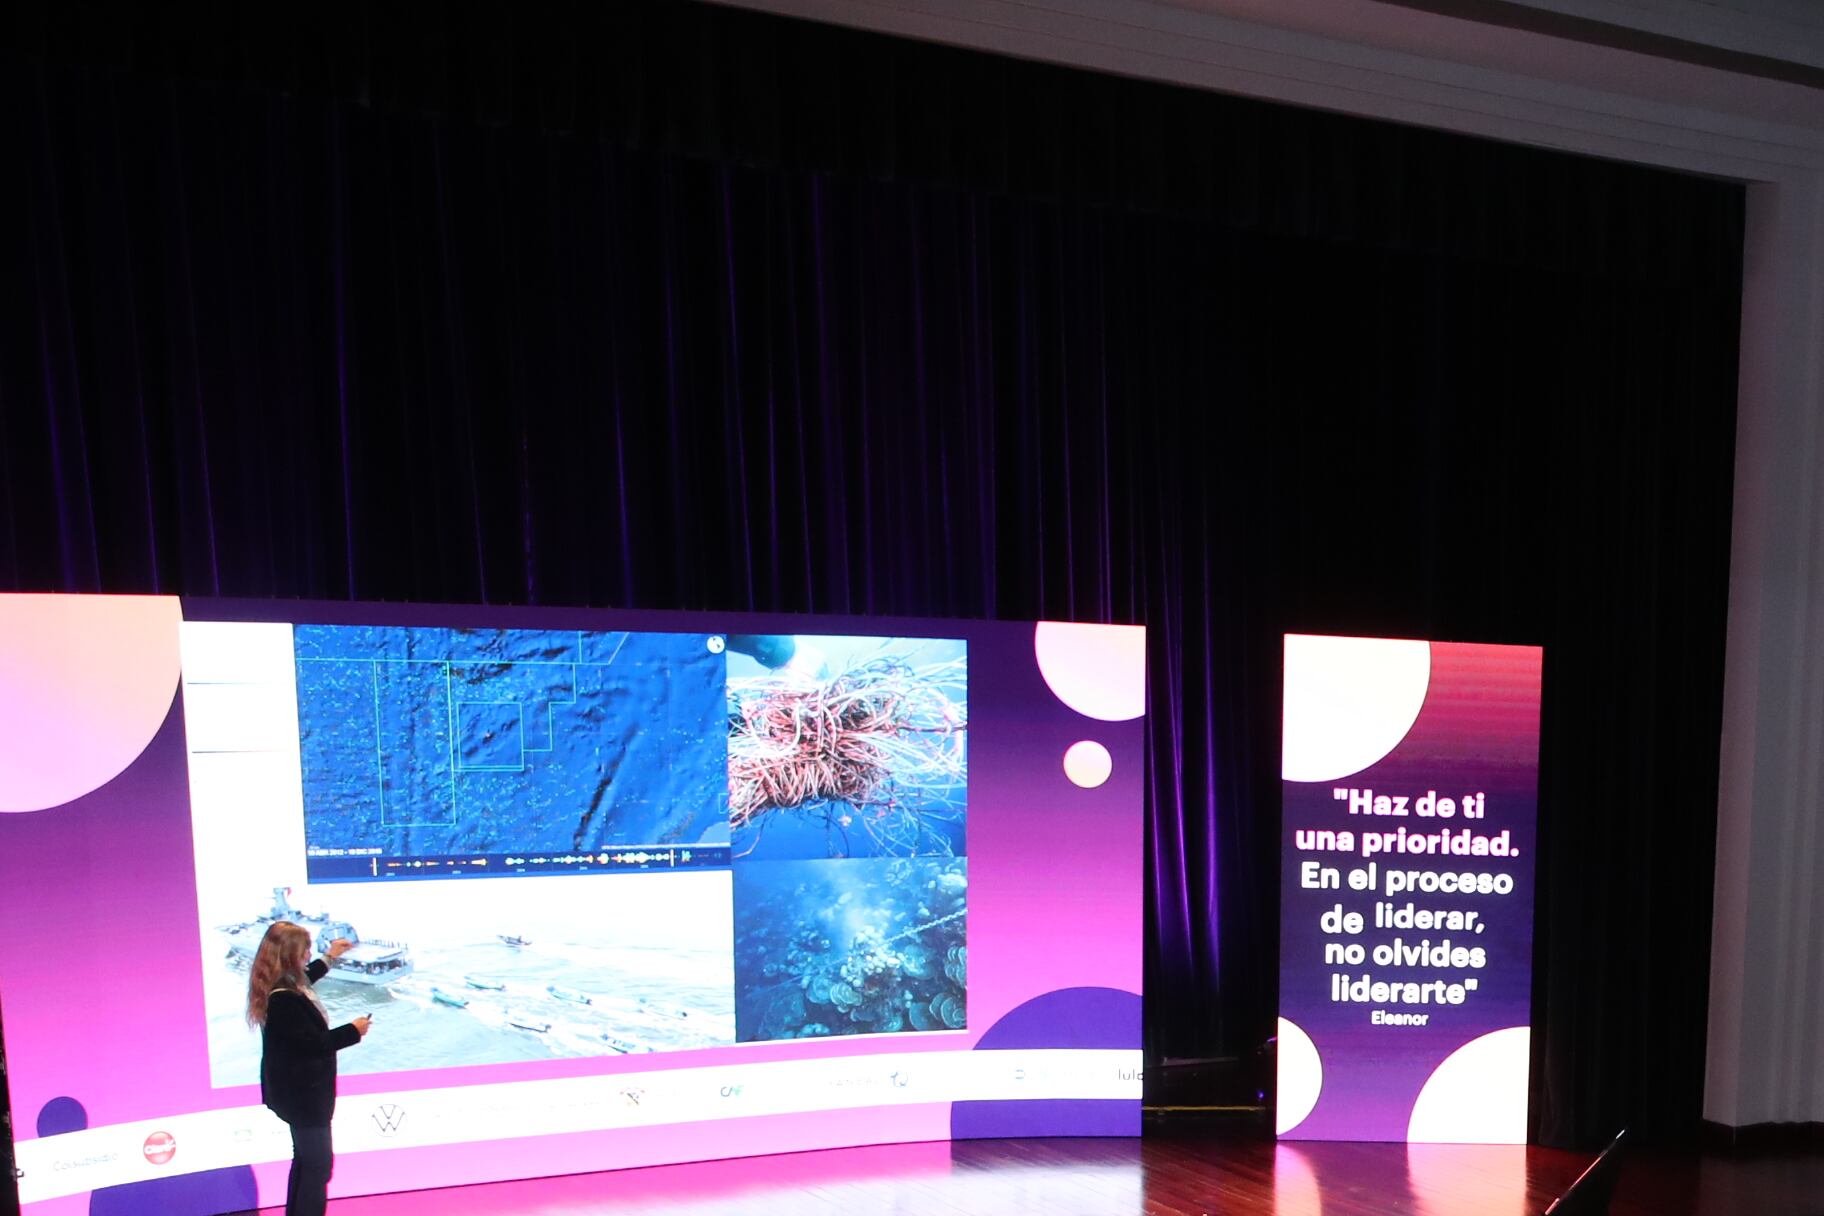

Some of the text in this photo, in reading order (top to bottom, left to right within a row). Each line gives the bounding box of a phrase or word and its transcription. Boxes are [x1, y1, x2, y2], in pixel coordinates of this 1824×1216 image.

[1334, 788, 1485, 818] "Haz de ti
[1296, 827, 1519, 857] una prioridad.
[1301, 861, 1514, 896] En el proceso
[1320, 902, 1485, 934] de liderar,
[1325, 938, 1486, 968] no olvides
[1331, 973, 1478, 1004] liderarte"
[1371, 1010, 1429, 1026] Eleanor
